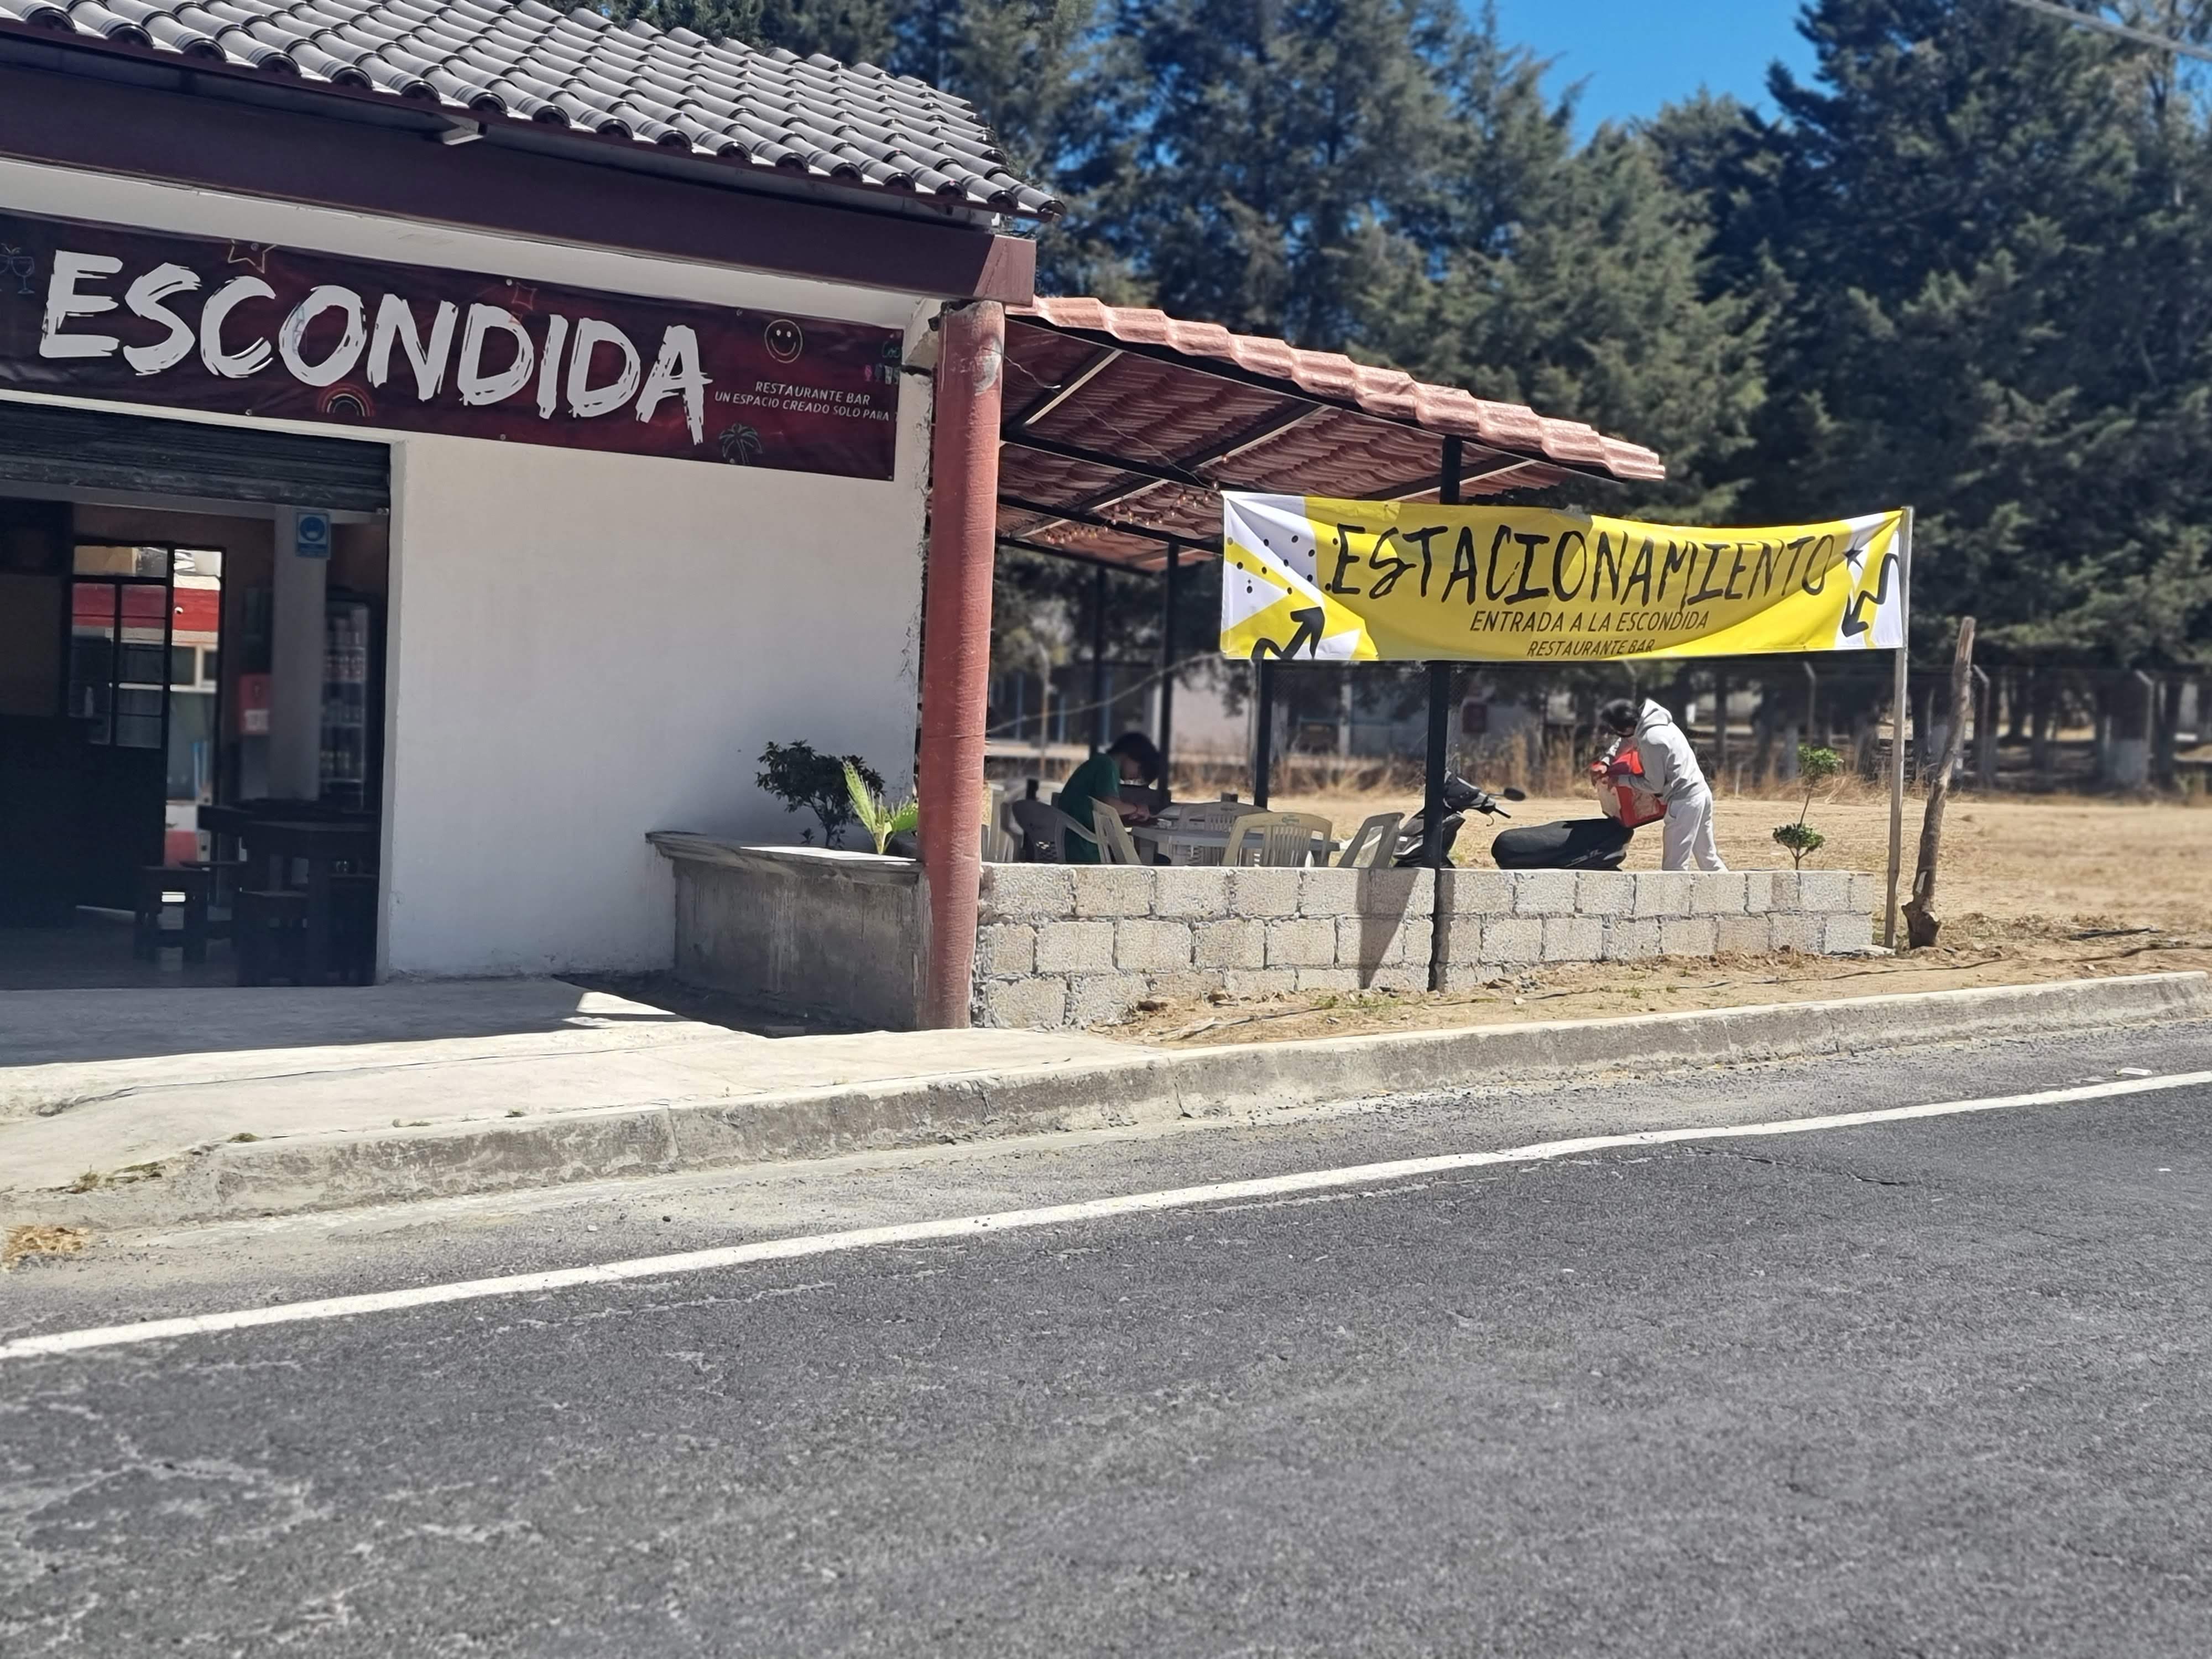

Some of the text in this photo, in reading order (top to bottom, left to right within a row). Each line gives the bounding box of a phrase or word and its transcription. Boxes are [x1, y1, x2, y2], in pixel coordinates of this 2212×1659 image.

[39, 249, 713, 445] ESCONDIDA
[714, 391, 731, 402] UN
[733, 393, 779, 408] ESPACIO
[782, 399, 830, 414] CREADO
[833, 405, 860, 417] SOLO
[863, 409, 889, 421] PARA
[755, 381, 870, 405] RESTAURANTE BAR
[1331, 523, 1835, 614] ESTACIONAMIENTO
[1469, 610, 1710, 633] ENTRADA A LA ESCONDIDA
[1526, 638, 1656, 658] RESTAURANTE BAR
